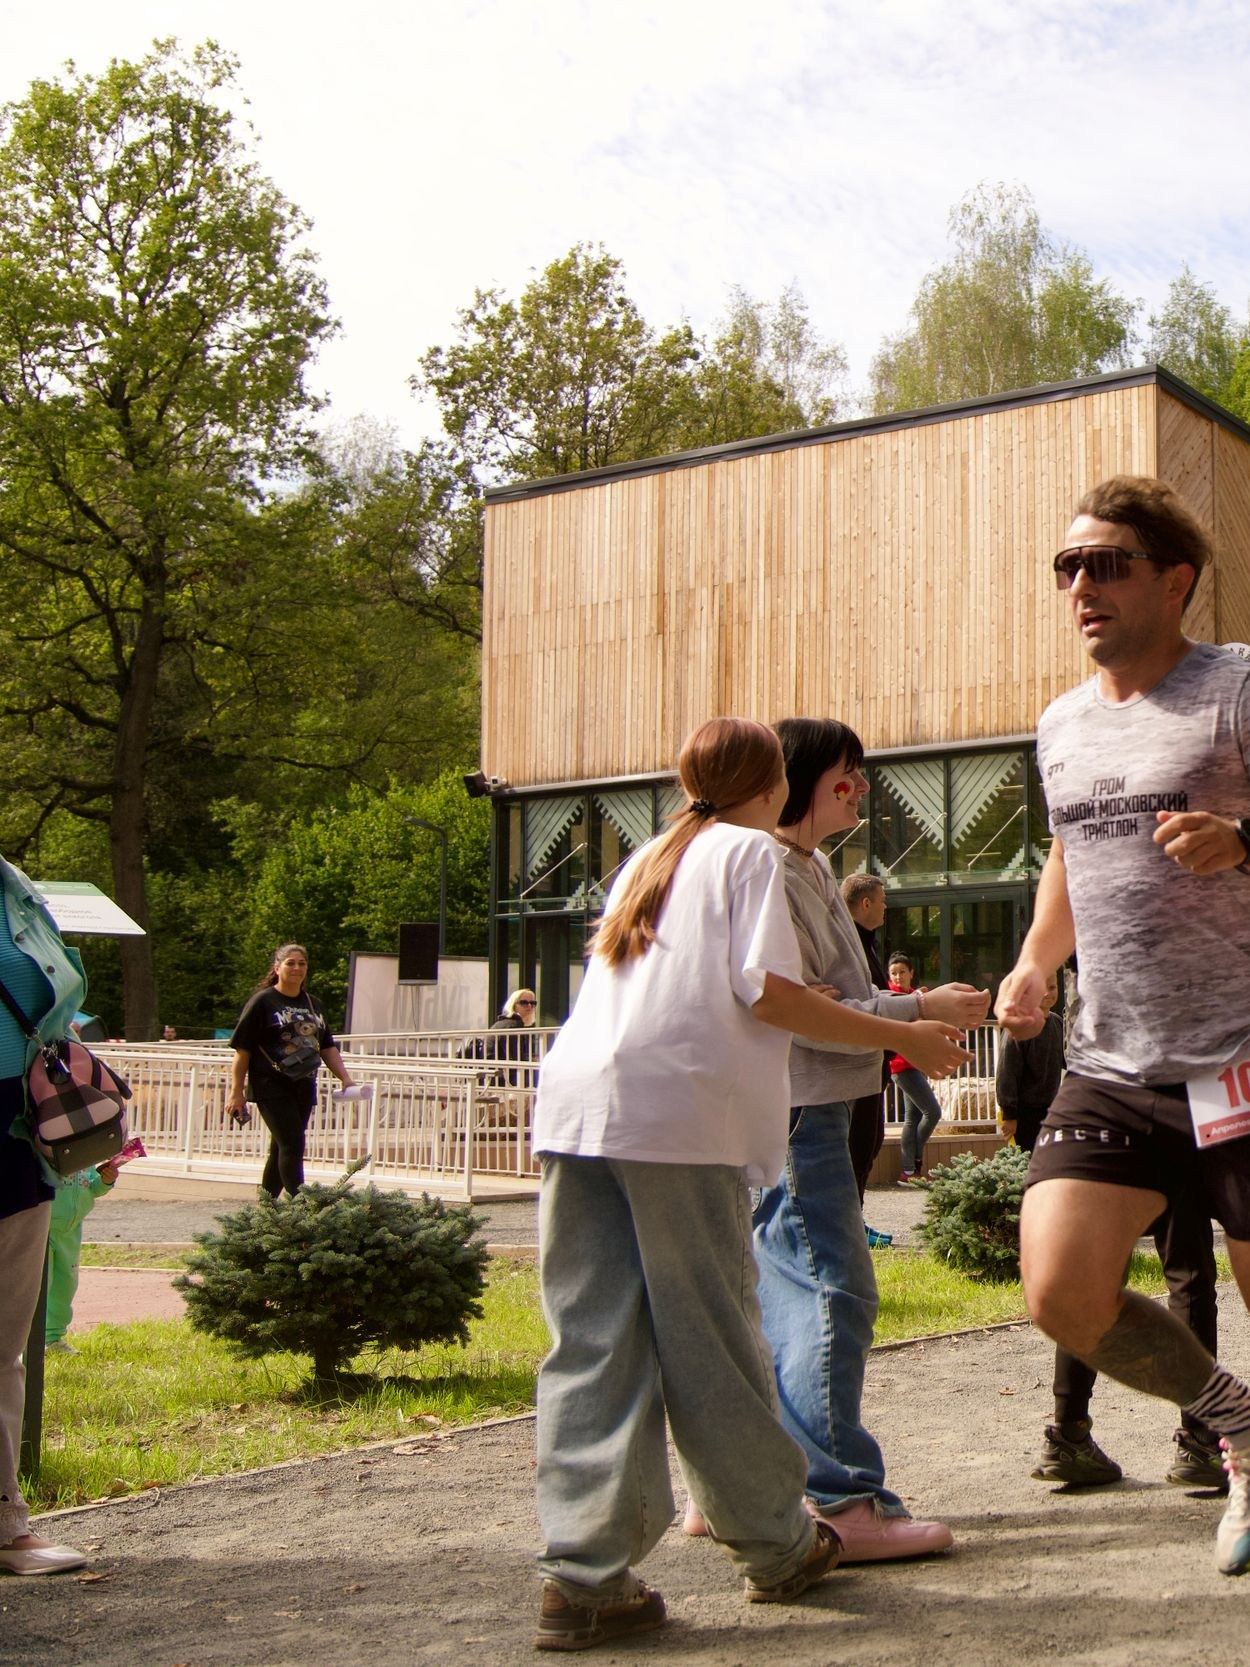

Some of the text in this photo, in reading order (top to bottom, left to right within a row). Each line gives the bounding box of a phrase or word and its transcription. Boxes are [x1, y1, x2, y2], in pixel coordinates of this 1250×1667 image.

[1092, 776, 1126, 797] ГРОМ
[1051, 790, 1188, 826] ОЛЬШОЙ МОСКОВСКИЙ
[1082, 818, 1138, 840] ТРИАТЛОН
